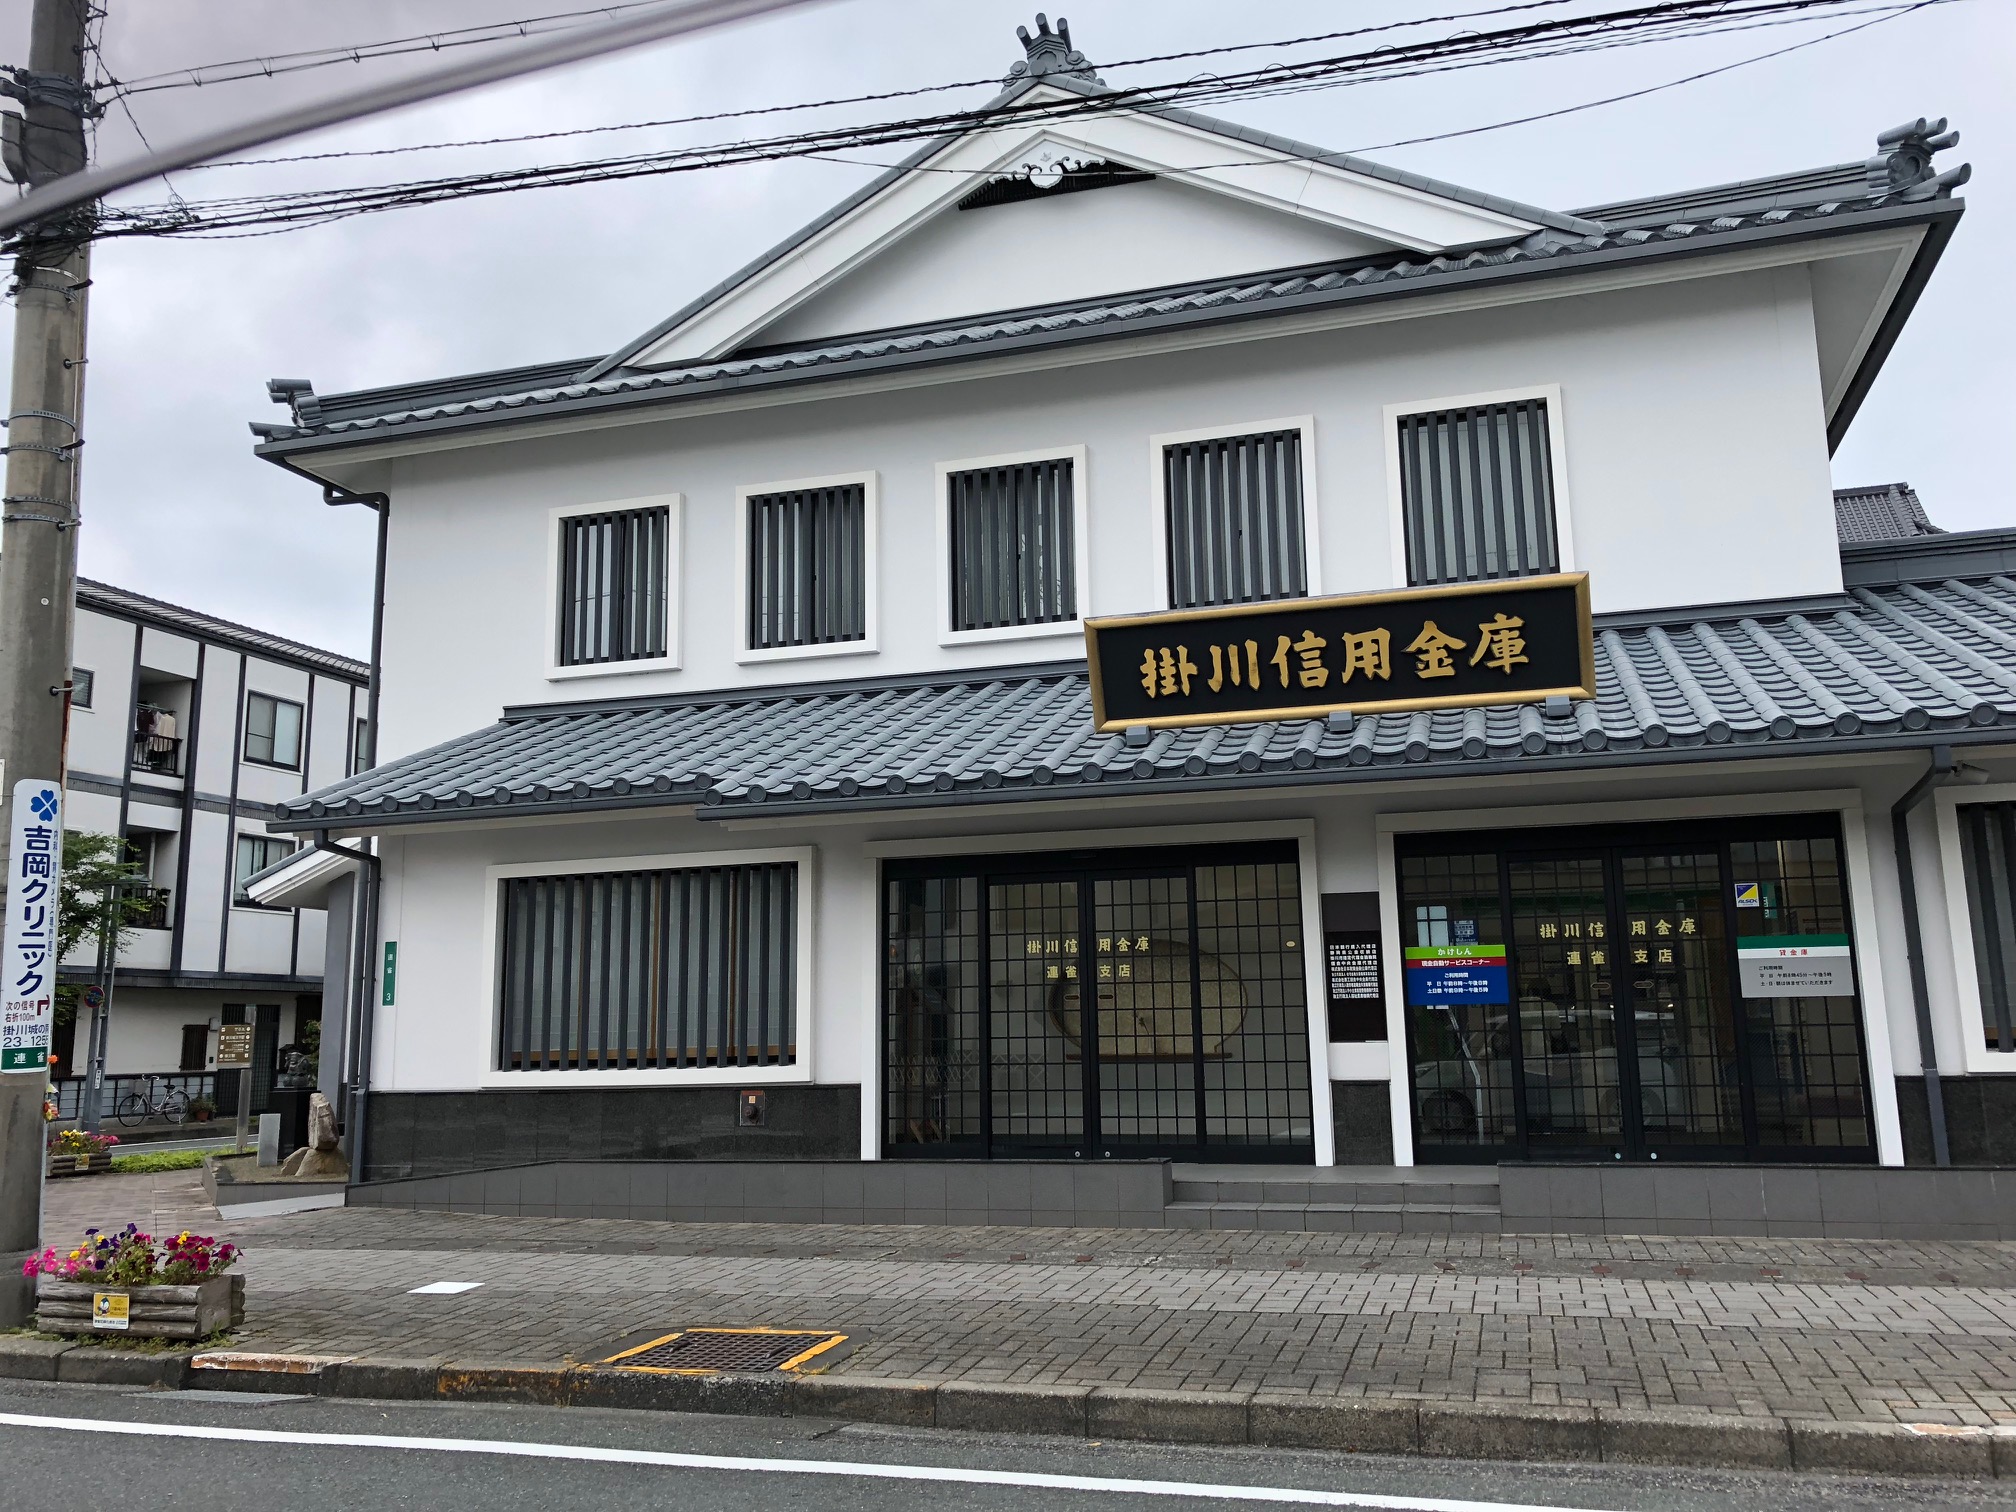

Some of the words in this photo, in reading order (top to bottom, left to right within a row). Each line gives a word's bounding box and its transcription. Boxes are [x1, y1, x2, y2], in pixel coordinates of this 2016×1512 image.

[1140, 613, 1530, 698] 掛川信用金庫
[16, 825, 52, 996] 吉岡クリニック
[1540, 917, 1696, 938] 掛川信用金庫
[1027, 936, 1150, 954] 掛川信用金庫
[1437, 947, 1472, 956] かけしん
[1567, 949, 1672, 965] 連雀支店
[1779, 948, 1808, 956] 貸金庫
[1421, 959, 1490, 967] 現金自動サービスコーナー
[1047, 964, 1131, 979] 連雀支店
[386, 992, 391, 1002] 3
[6, 1000, 35, 1011] 次の信号
[5, 1013, 35, 1023] 右折100m
[14, 1051, 45, 1064] 連雀
